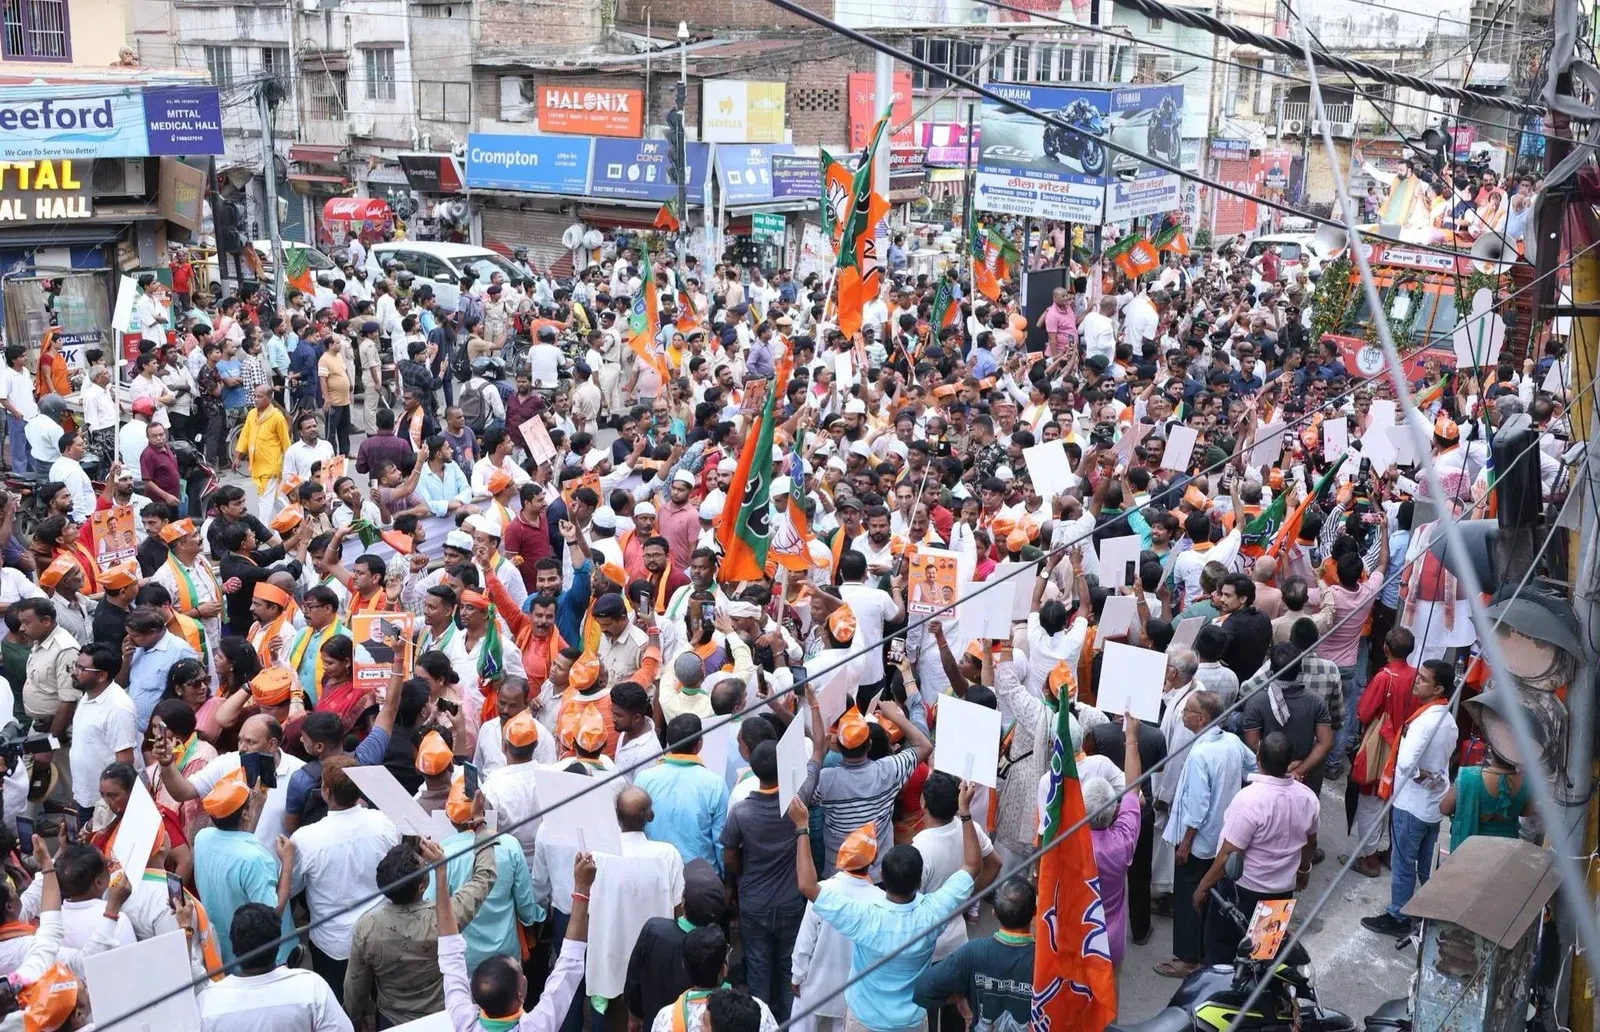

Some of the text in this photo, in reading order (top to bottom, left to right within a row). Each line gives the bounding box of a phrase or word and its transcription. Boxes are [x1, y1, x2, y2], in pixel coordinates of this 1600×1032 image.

[999, 88, 1031, 100] YAMAHA
[1121, 92, 1141, 102] YAMAHA
[546, 90, 630, 113] HALONIX
[167, 109, 201, 118] MITTAL
[150, 121, 219, 131] MEDICAL HALL
[43, 148, 61, 156] Serve
[63, 148, 75, 156] You
[75, 147, 97, 155] Better!
[471, 147, 538, 168] Crompton
[1007, 178, 1070, 194] लीला मोटर्स
[1041, 193, 1062, 202] Service
[35, 196, 91, 219] HALL
[1384, 251, 1391, 260] 2
